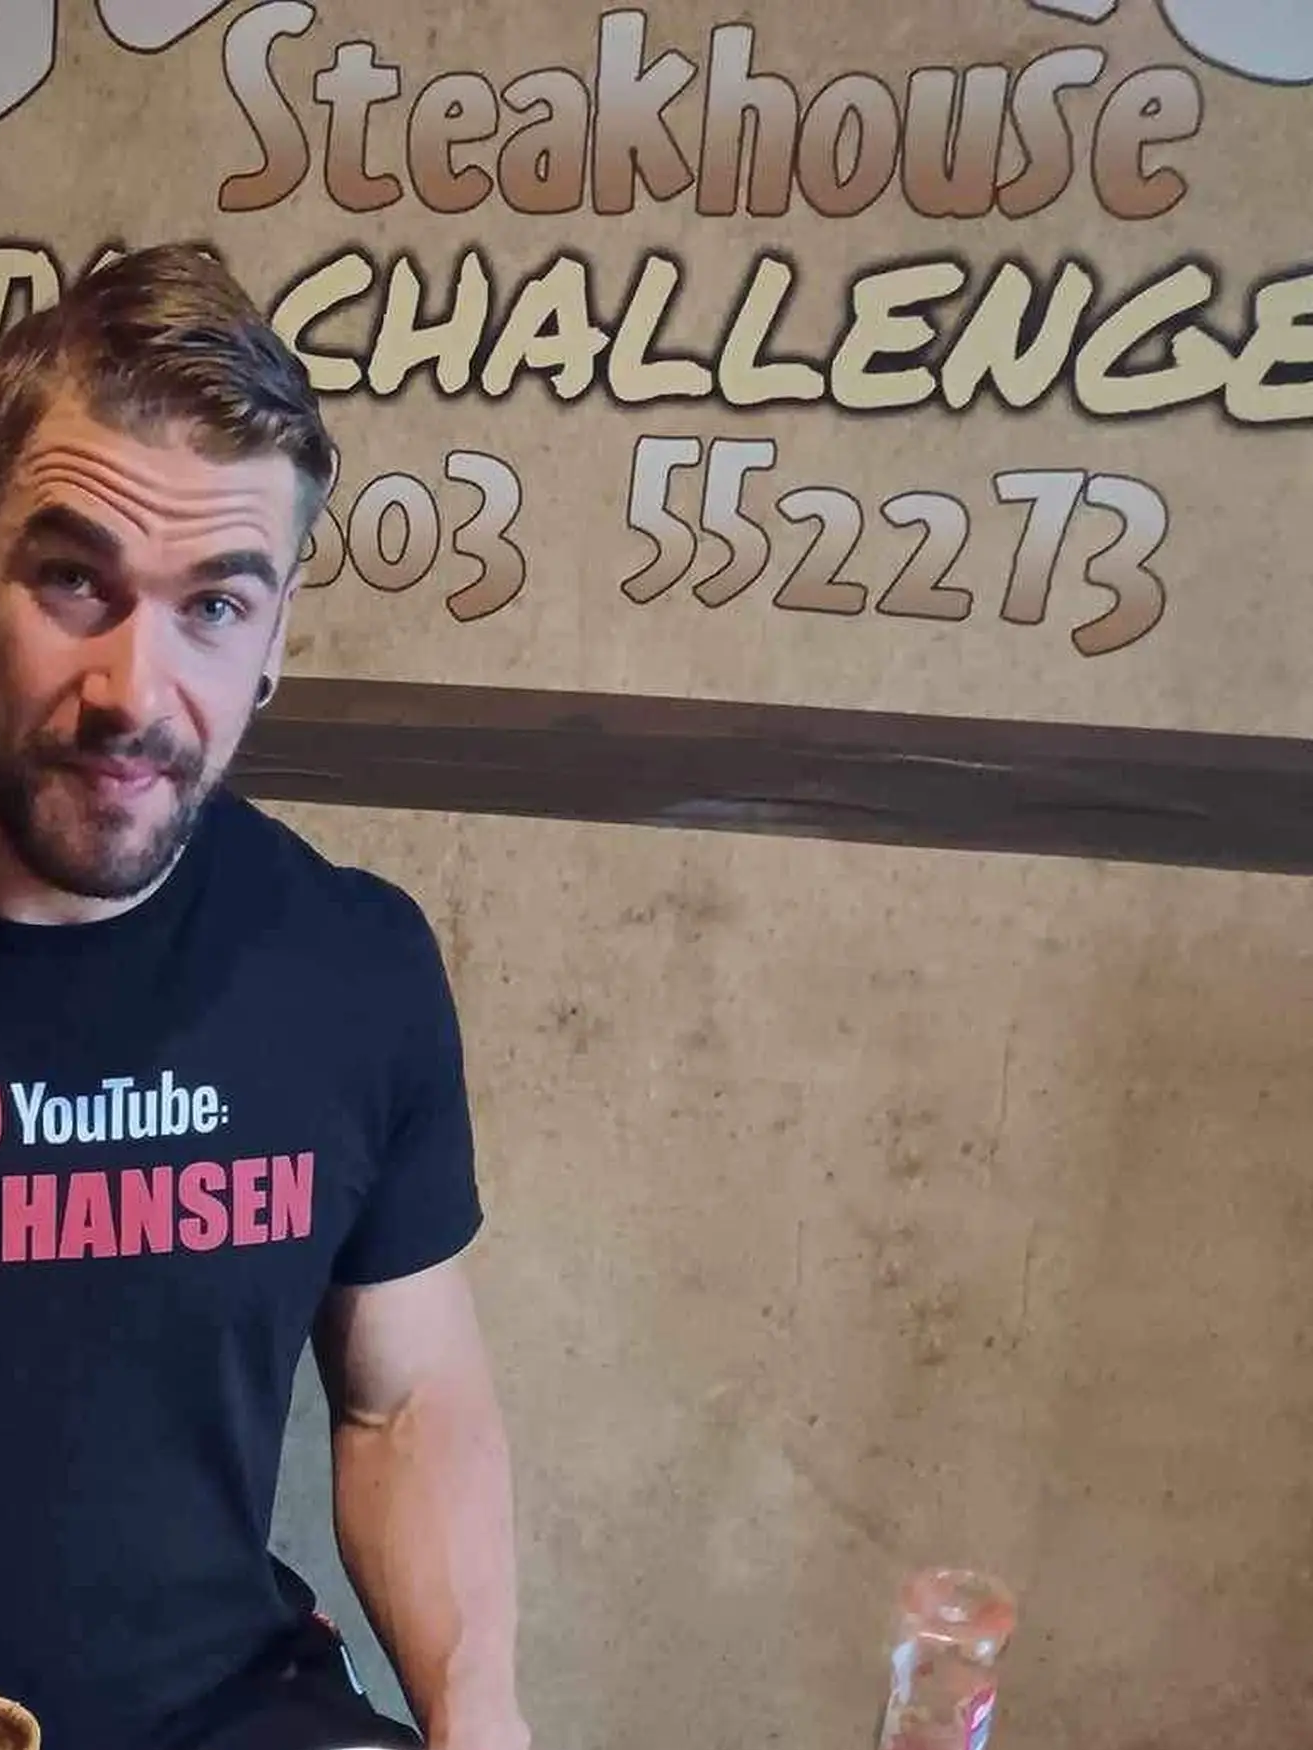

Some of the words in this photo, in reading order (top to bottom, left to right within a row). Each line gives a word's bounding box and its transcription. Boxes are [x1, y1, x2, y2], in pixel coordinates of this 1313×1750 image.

[218, 0, 1204, 218] Steakhouse
[271, 248, 1313, 424] CHALLENGE
[620, 435, 1169, 657] 552273
[0, 1150, 316, 1264] HANSEN
